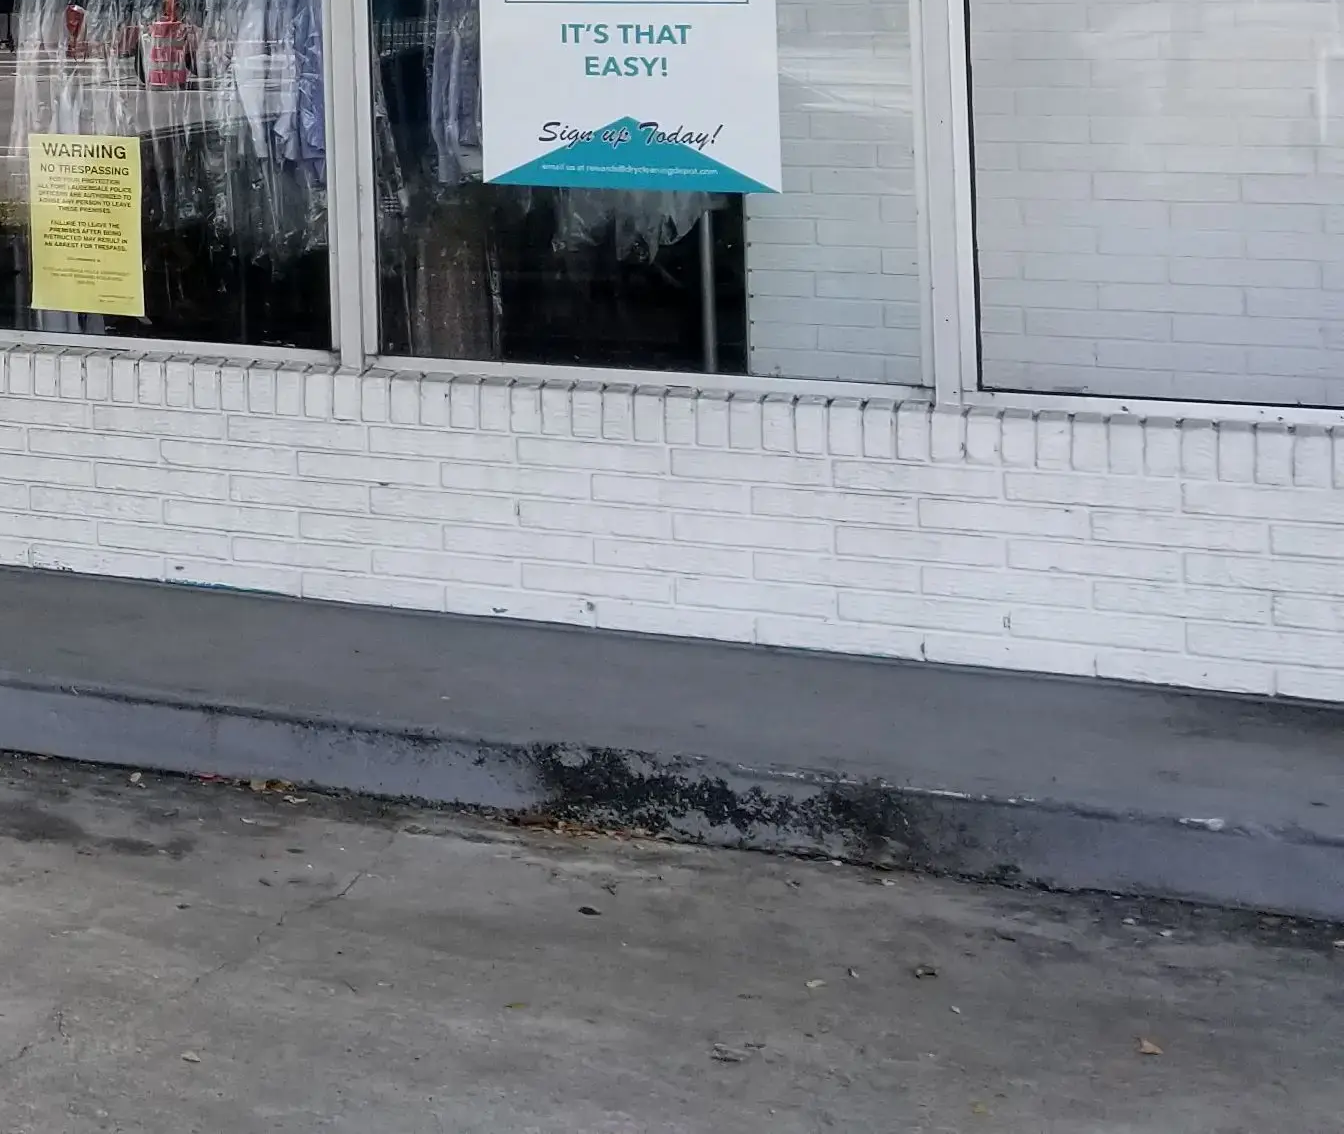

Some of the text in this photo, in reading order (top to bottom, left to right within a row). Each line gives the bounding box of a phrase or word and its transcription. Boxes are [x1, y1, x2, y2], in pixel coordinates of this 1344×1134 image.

[561, 23, 692, 44] IT'S THAT
[585, 56, 668, 77] EASY!
[538, 121, 724, 150] Sign up Today!
[42, 142, 127, 159] WARNING
[40, 163, 130, 176] NO TRESPASSING
